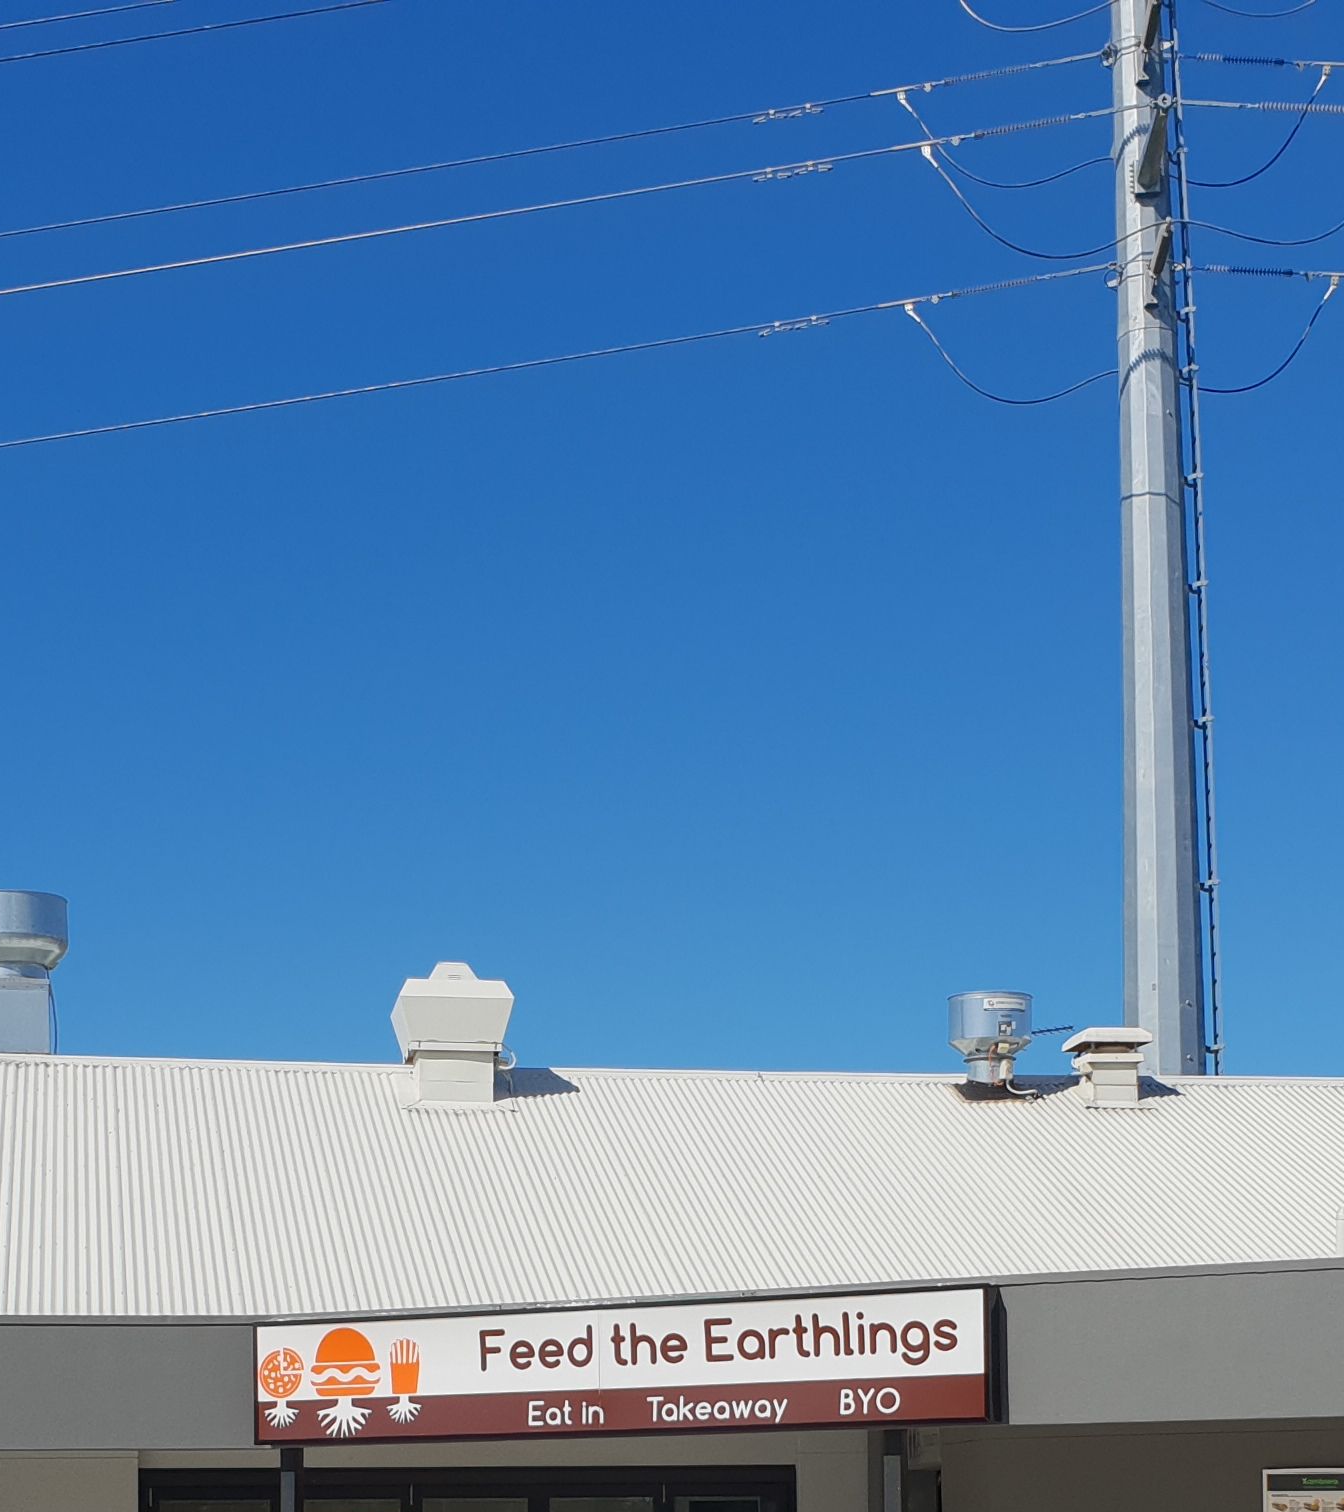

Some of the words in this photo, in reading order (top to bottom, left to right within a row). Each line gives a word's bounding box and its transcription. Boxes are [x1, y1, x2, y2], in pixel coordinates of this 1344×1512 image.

[478, 1323, 594, 1372] Feed
[610, 1322, 689, 1367] the
[704, 1311, 958, 1366] Earthlings
[528, 1399, 574, 1426] Eat
[581, 1400, 605, 1425] in
[646, 1394, 788, 1424] Takeaway
[838, 1387, 901, 1416] BYO
